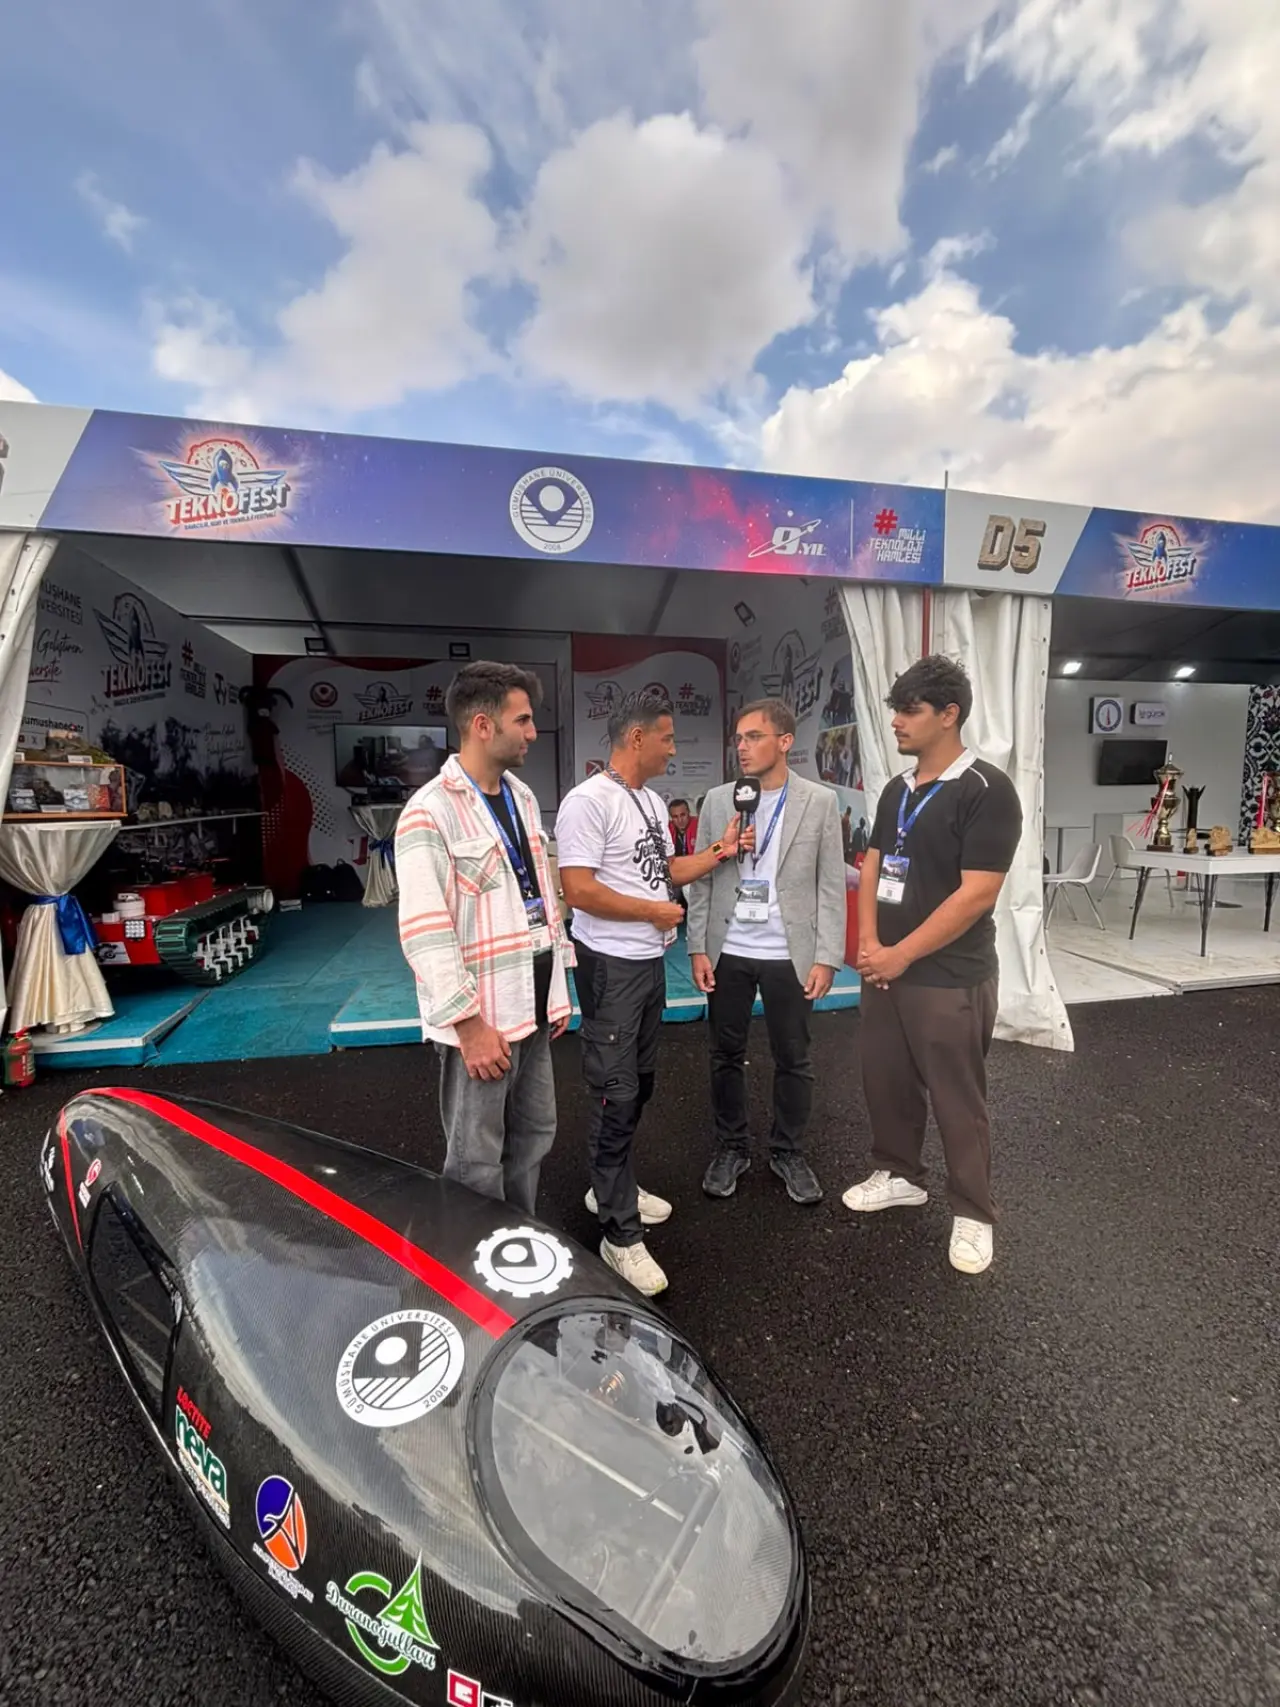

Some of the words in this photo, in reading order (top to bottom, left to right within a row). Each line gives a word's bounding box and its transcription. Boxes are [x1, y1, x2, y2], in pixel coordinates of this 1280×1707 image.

[166, 482, 291, 525] TEKNOFEST
[977, 514, 1047, 574] D5
[1125, 556, 1197, 589] TEKNOFEST
[102, 657, 172, 698] TEKNOFEST
[422, 1384, 449, 1409] 2008
